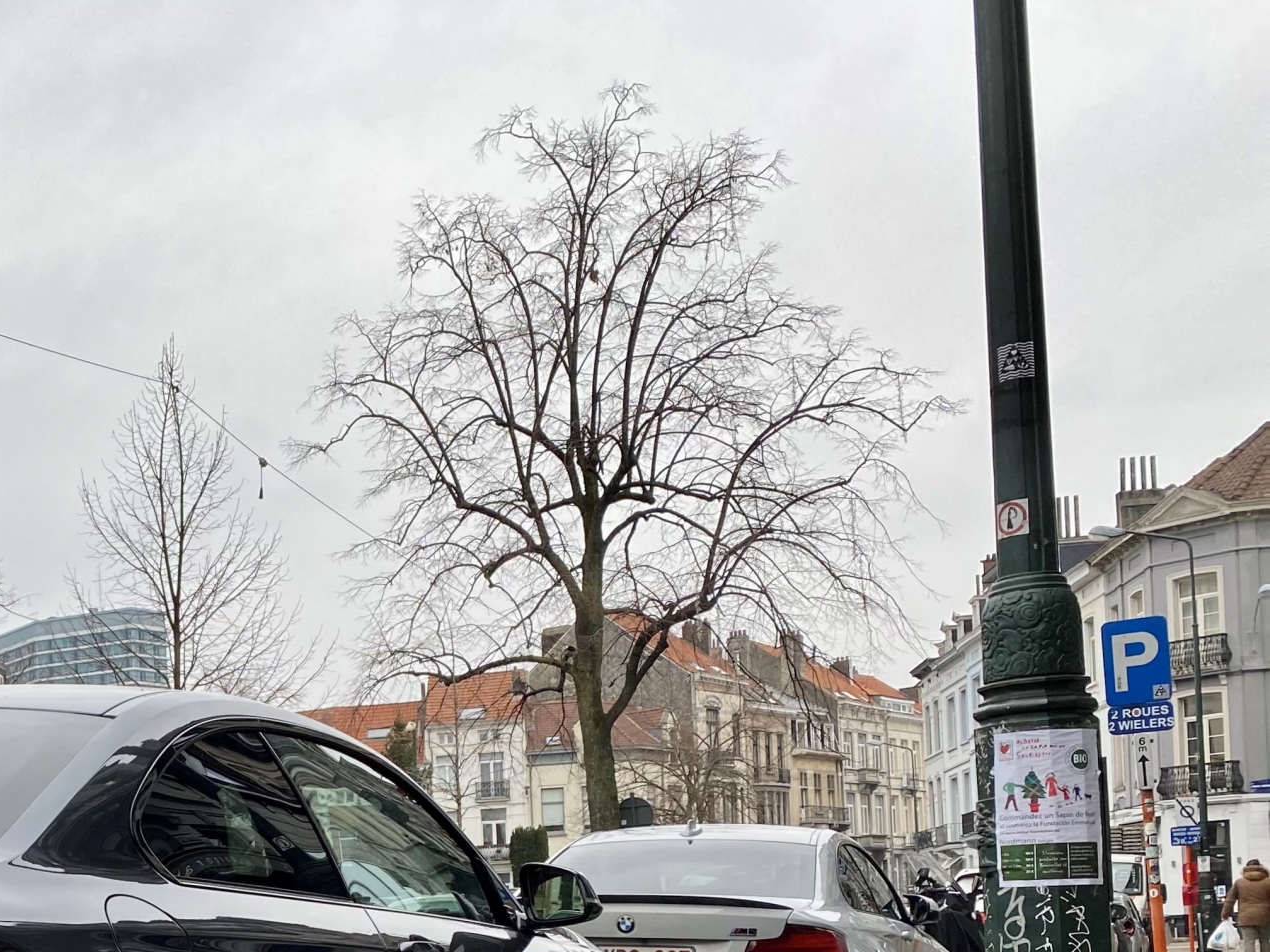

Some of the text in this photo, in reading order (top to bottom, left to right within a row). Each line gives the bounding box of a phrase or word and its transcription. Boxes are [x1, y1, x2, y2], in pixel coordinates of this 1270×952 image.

[1111, 631, 1159, 693] P
[1111, 705, 1170, 720] 2 ROUES
[1109, 717, 1175, 732] 2 WIELERS
[1139, 737, 1146, 746] 6
[1073, 753, 1087, 763] BIO
[999, 813, 1043, 821] Commandez
[1055, 811, 1074, 820] Sapin
